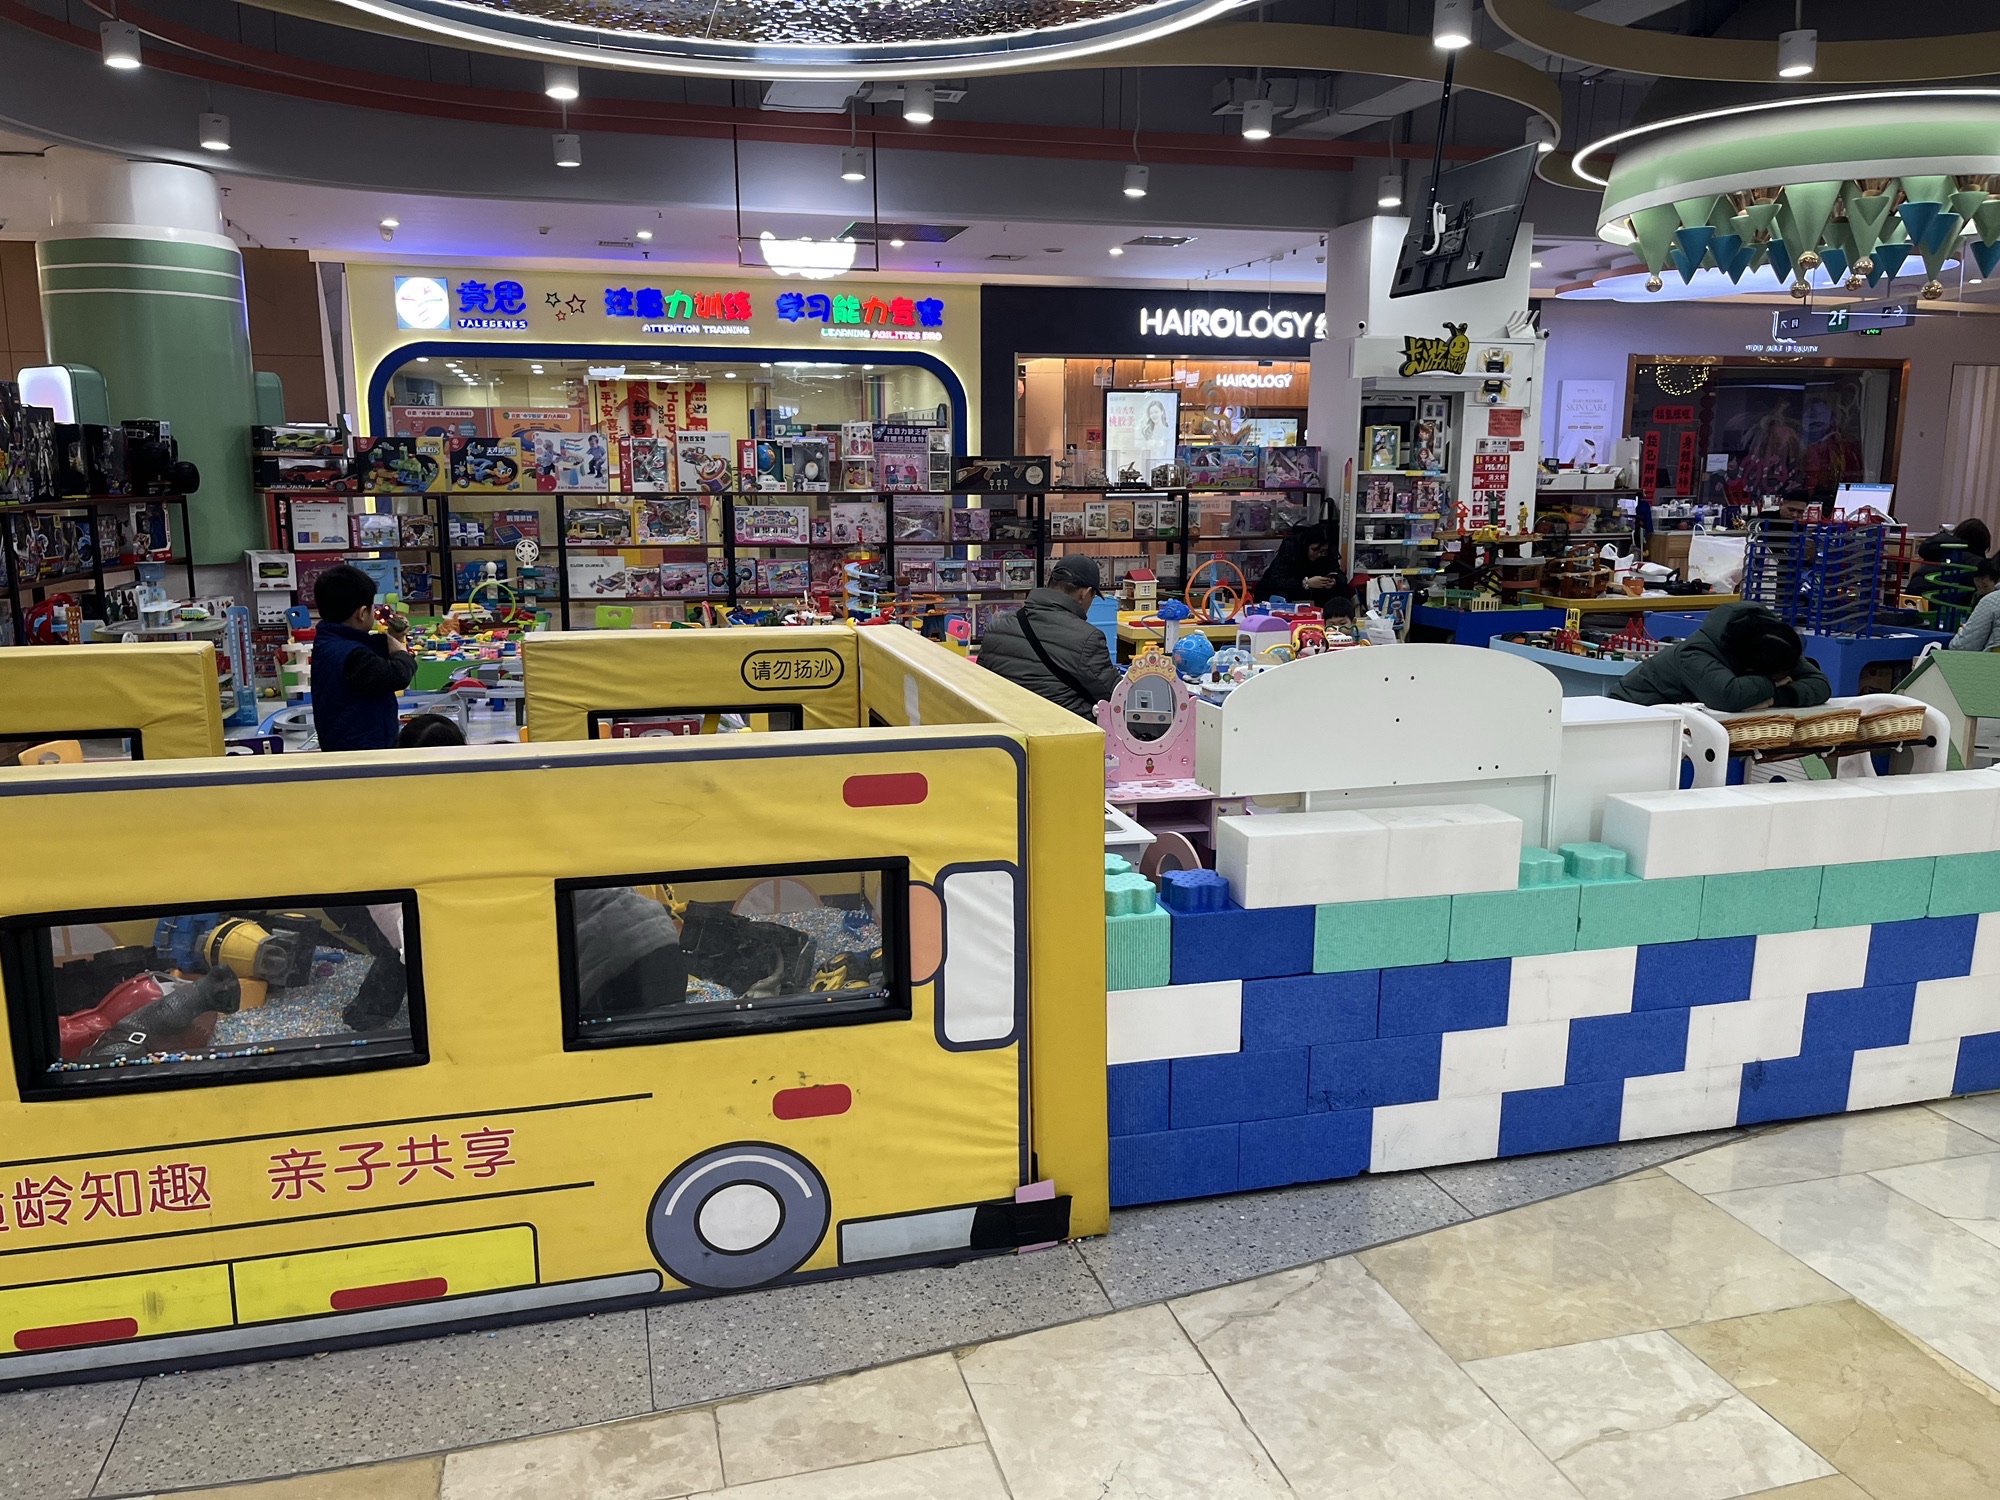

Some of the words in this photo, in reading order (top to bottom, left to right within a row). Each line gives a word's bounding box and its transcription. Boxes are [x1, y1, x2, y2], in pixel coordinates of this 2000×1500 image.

[604, 287, 752, 321] 注意力训练
[776, 292, 944, 327] 学习能力专家
[457, 318, 528, 329] TALEGENES
[642, 323, 700, 333] ATTENTION
[703, 325, 750, 335] TRAINING
[1140, 306, 1313, 338] HAIROLOGY
[1828, 308, 1847, 327] 2F
[821, 328, 870, 339] LEARNING
[872, 330, 921, 341] ABILITIES
[1216, 373, 1293, 389] HAIROLOGY
[631, 400, 650, 436] 新春
[664, 391, 678, 442] Happy
[887, 427, 927, 436] 注意力缺乏的
[751, 658, 834, 681] 请勿扬沙
[267, 1126, 516, 1200] 亲子共享
